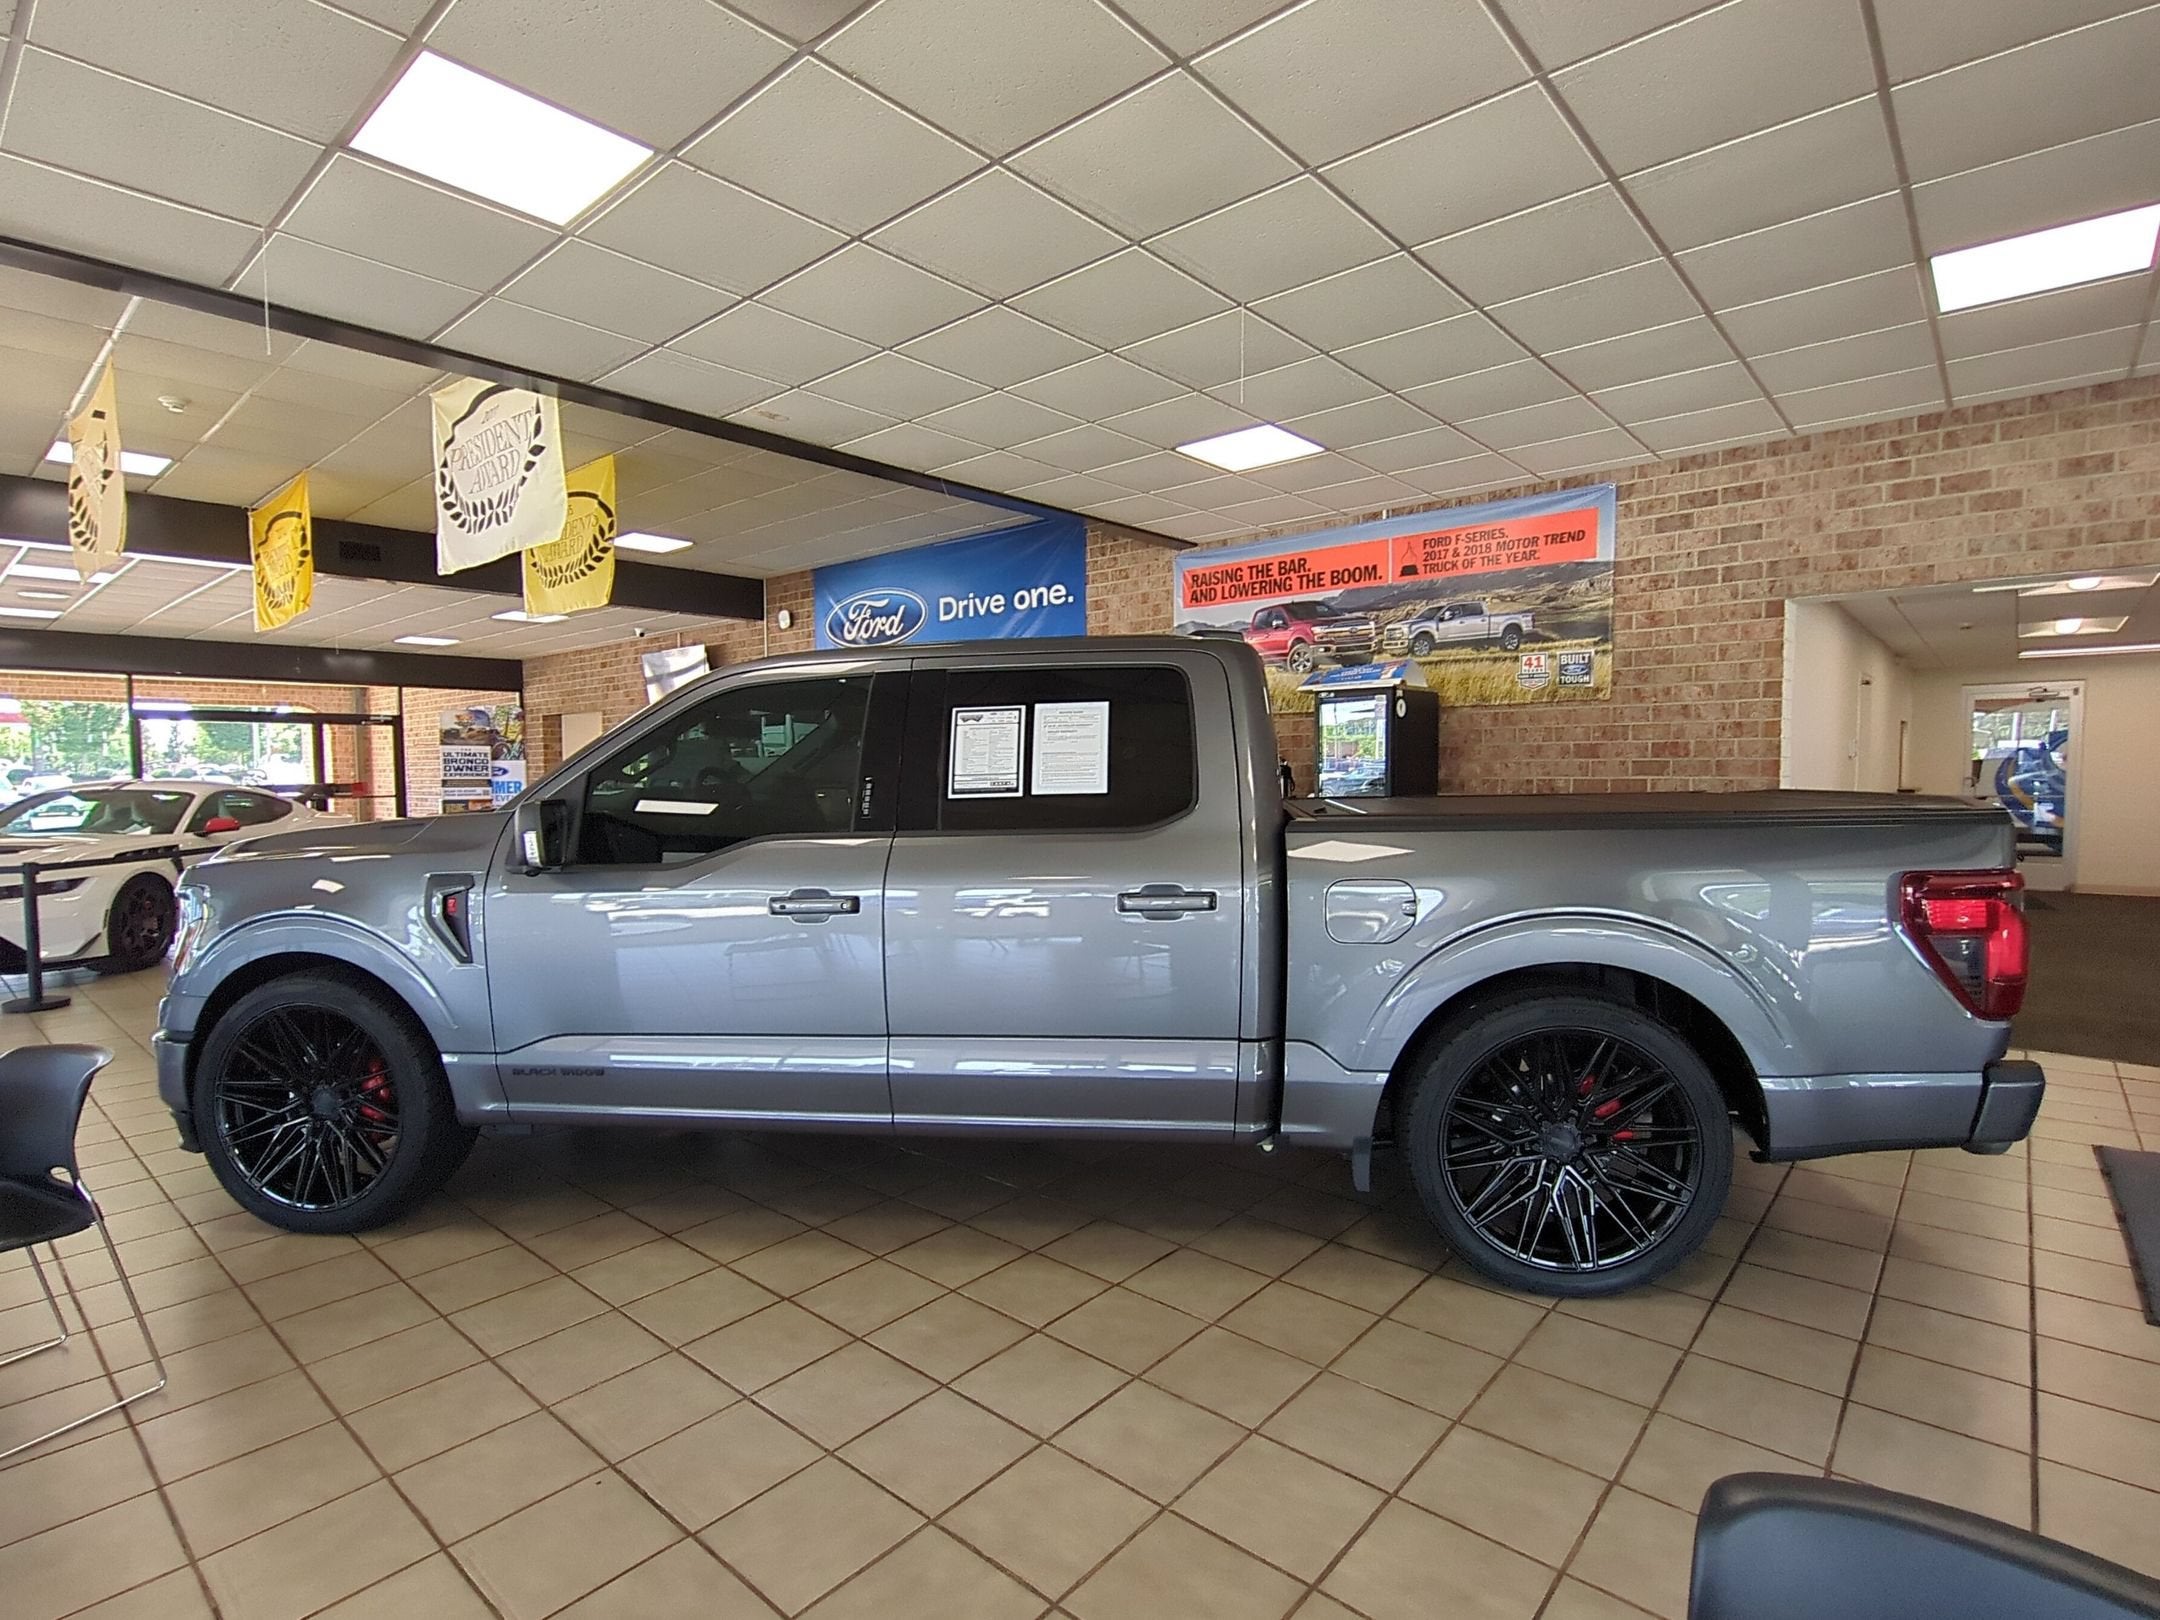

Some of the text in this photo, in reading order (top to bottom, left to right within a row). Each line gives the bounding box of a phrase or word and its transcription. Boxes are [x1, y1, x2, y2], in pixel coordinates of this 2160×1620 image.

[451, 408, 532, 471] PRESIDENT
[468, 449, 520, 494] AWARD
[1423, 528, 1509, 549] FORD F-SERIES.
[1423, 529, 1586, 562] 2017 & 2018 MOTOR TREND
[1191, 557, 1311, 588] RAISING THE BAR.
[1422, 561, 1459, 574] TRUCK
[1461, 558, 1476, 569] OF
[1480, 554, 1502, 567] THE
[1190, 564, 1383, 603] AND LOWERING THE BOOM.
[939, 583, 1074, 621] Drive one.
[843, 598, 905, 640] Ford
[1523, 656, 1543, 668] 41
[1560, 653, 1590, 664] BUILT
[1560, 674, 1590, 684] TOUGH
[492, 781, 522, 794] MER
